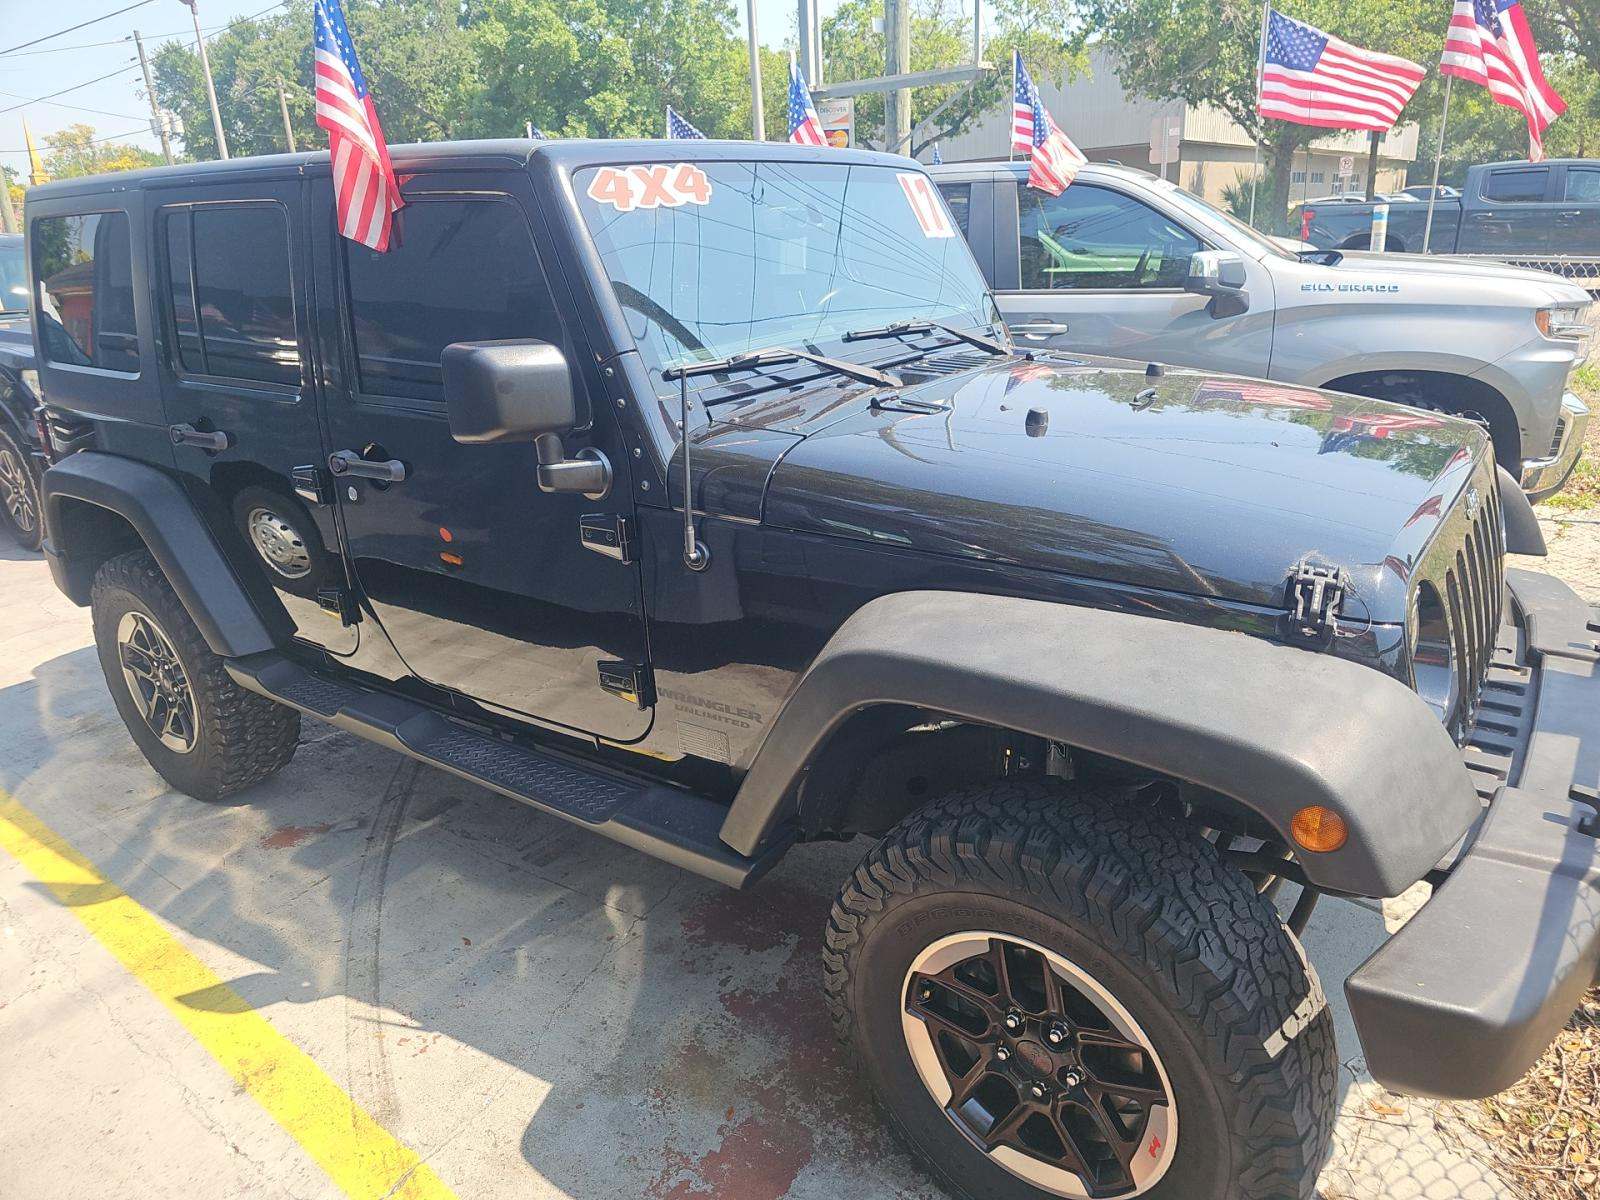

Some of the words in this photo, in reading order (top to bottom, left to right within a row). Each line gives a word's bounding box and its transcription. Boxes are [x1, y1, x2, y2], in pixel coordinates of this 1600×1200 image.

[588, 165, 711, 210] 4X4
[1300, 283, 1400, 293] SILVERADO
[656, 686, 763, 724] WRANGLER
[674, 703, 750, 729] UNLIMITED
